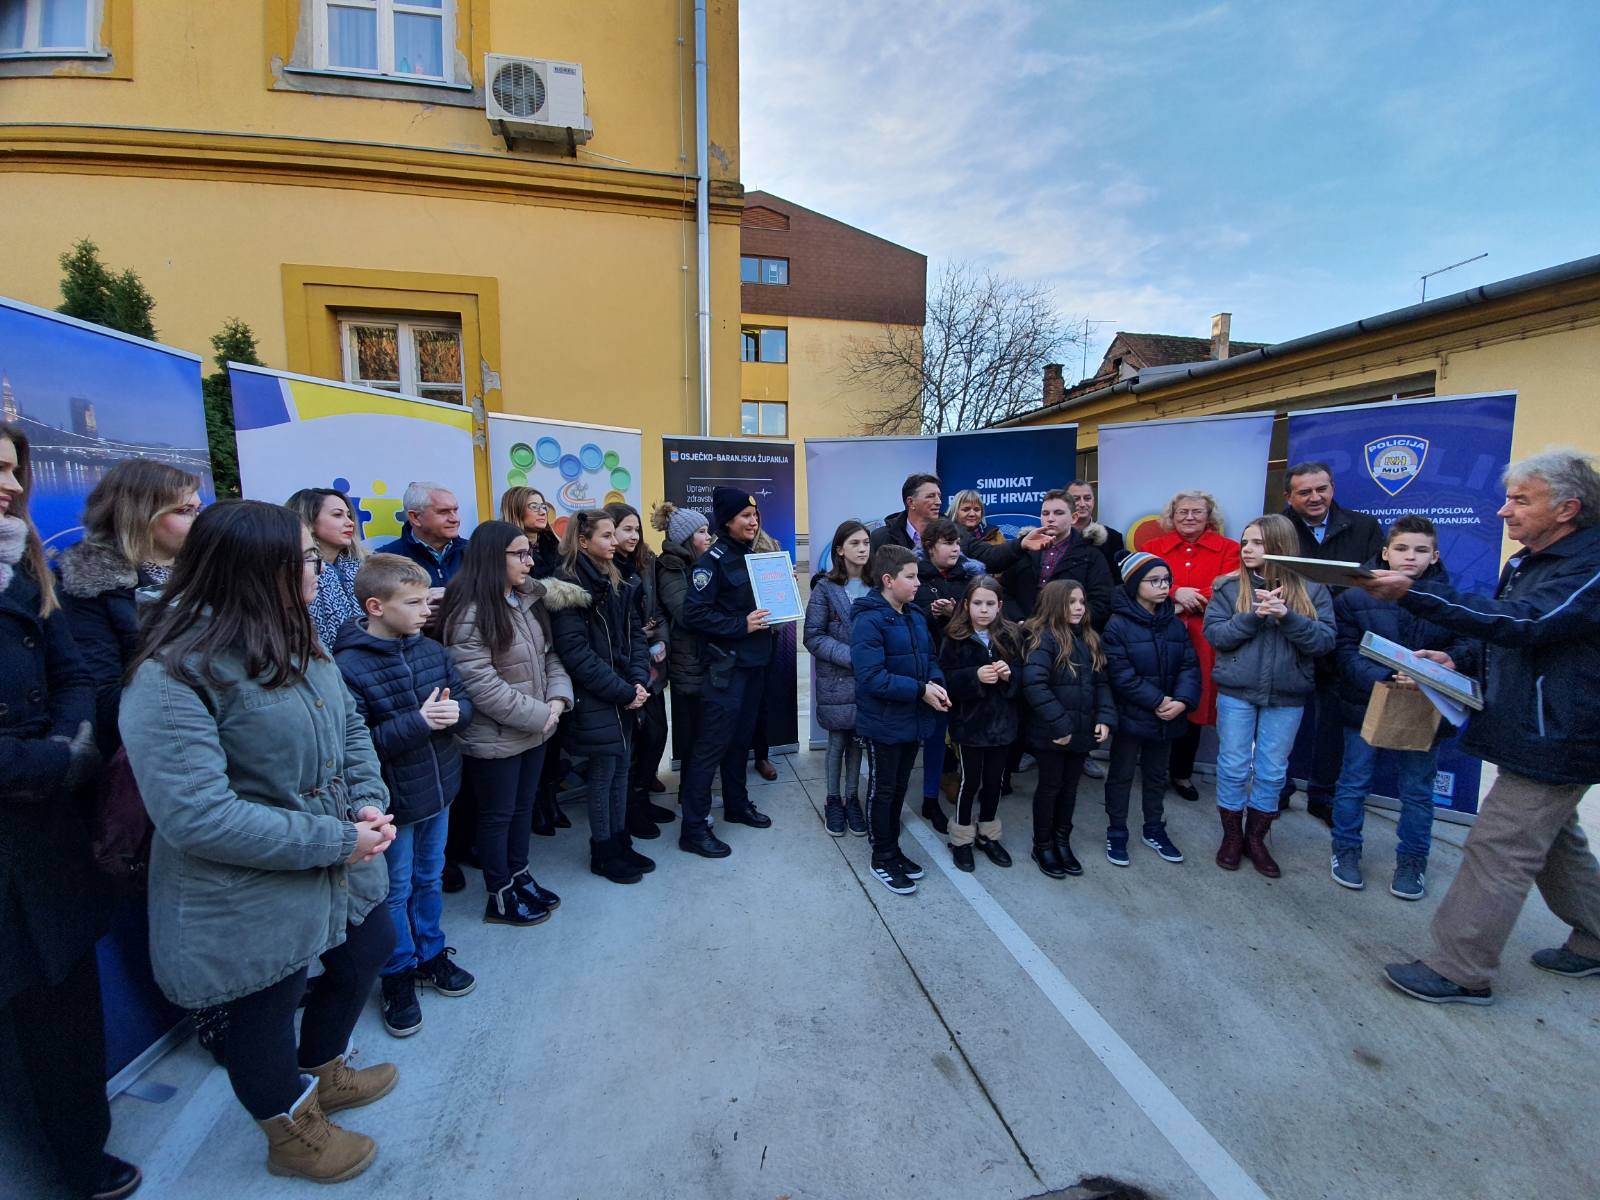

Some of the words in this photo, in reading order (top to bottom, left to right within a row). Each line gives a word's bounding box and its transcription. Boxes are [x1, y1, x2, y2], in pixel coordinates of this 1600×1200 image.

[1368, 439, 1425, 452] POLICIJA
[680, 452, 757, 463] OSJEČKO-BARANJSKA
[757, 454, 789, 464] ŽUPANIJA
[1385, 455, 1407, 466] RH
[976, 476, 1034, 489] SINDIKAT
[686, 484, 712, 494] Upravni
[686, 494, 714, 503] zdravstv
[1000, 491, 1048, 504] HRVATS
[690, 505, 714, 514] socijal
[1371, 508, 1429, 516] UNUTARNJIH
[1430, 507, 1474, 515] POSLOVA
